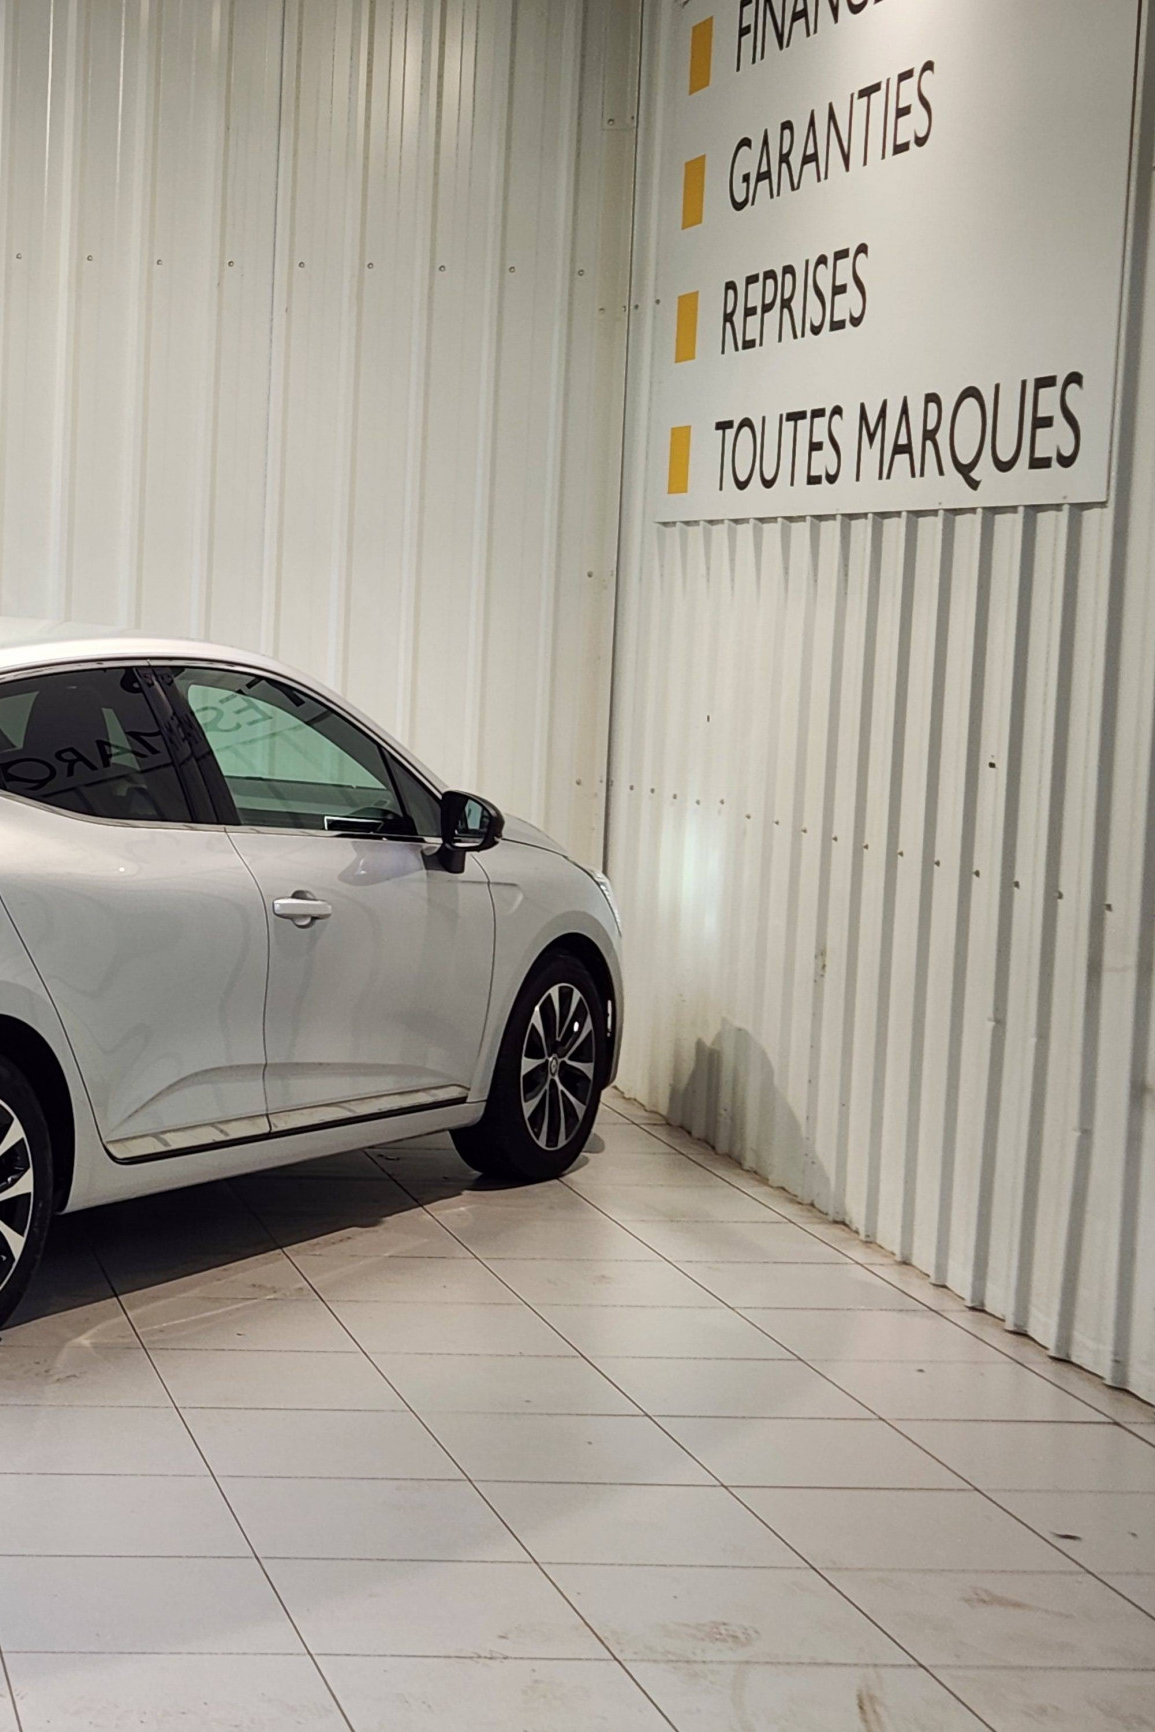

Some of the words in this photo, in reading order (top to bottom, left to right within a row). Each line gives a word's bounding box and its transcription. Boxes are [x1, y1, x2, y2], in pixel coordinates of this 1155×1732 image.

[728, 60, 935, 212] GARANTIES
[721, 242, 869, 355] REPRISES
[714, 404, 844, 492] TOUTES
[855, 371, 1084, 492] MARQUES
